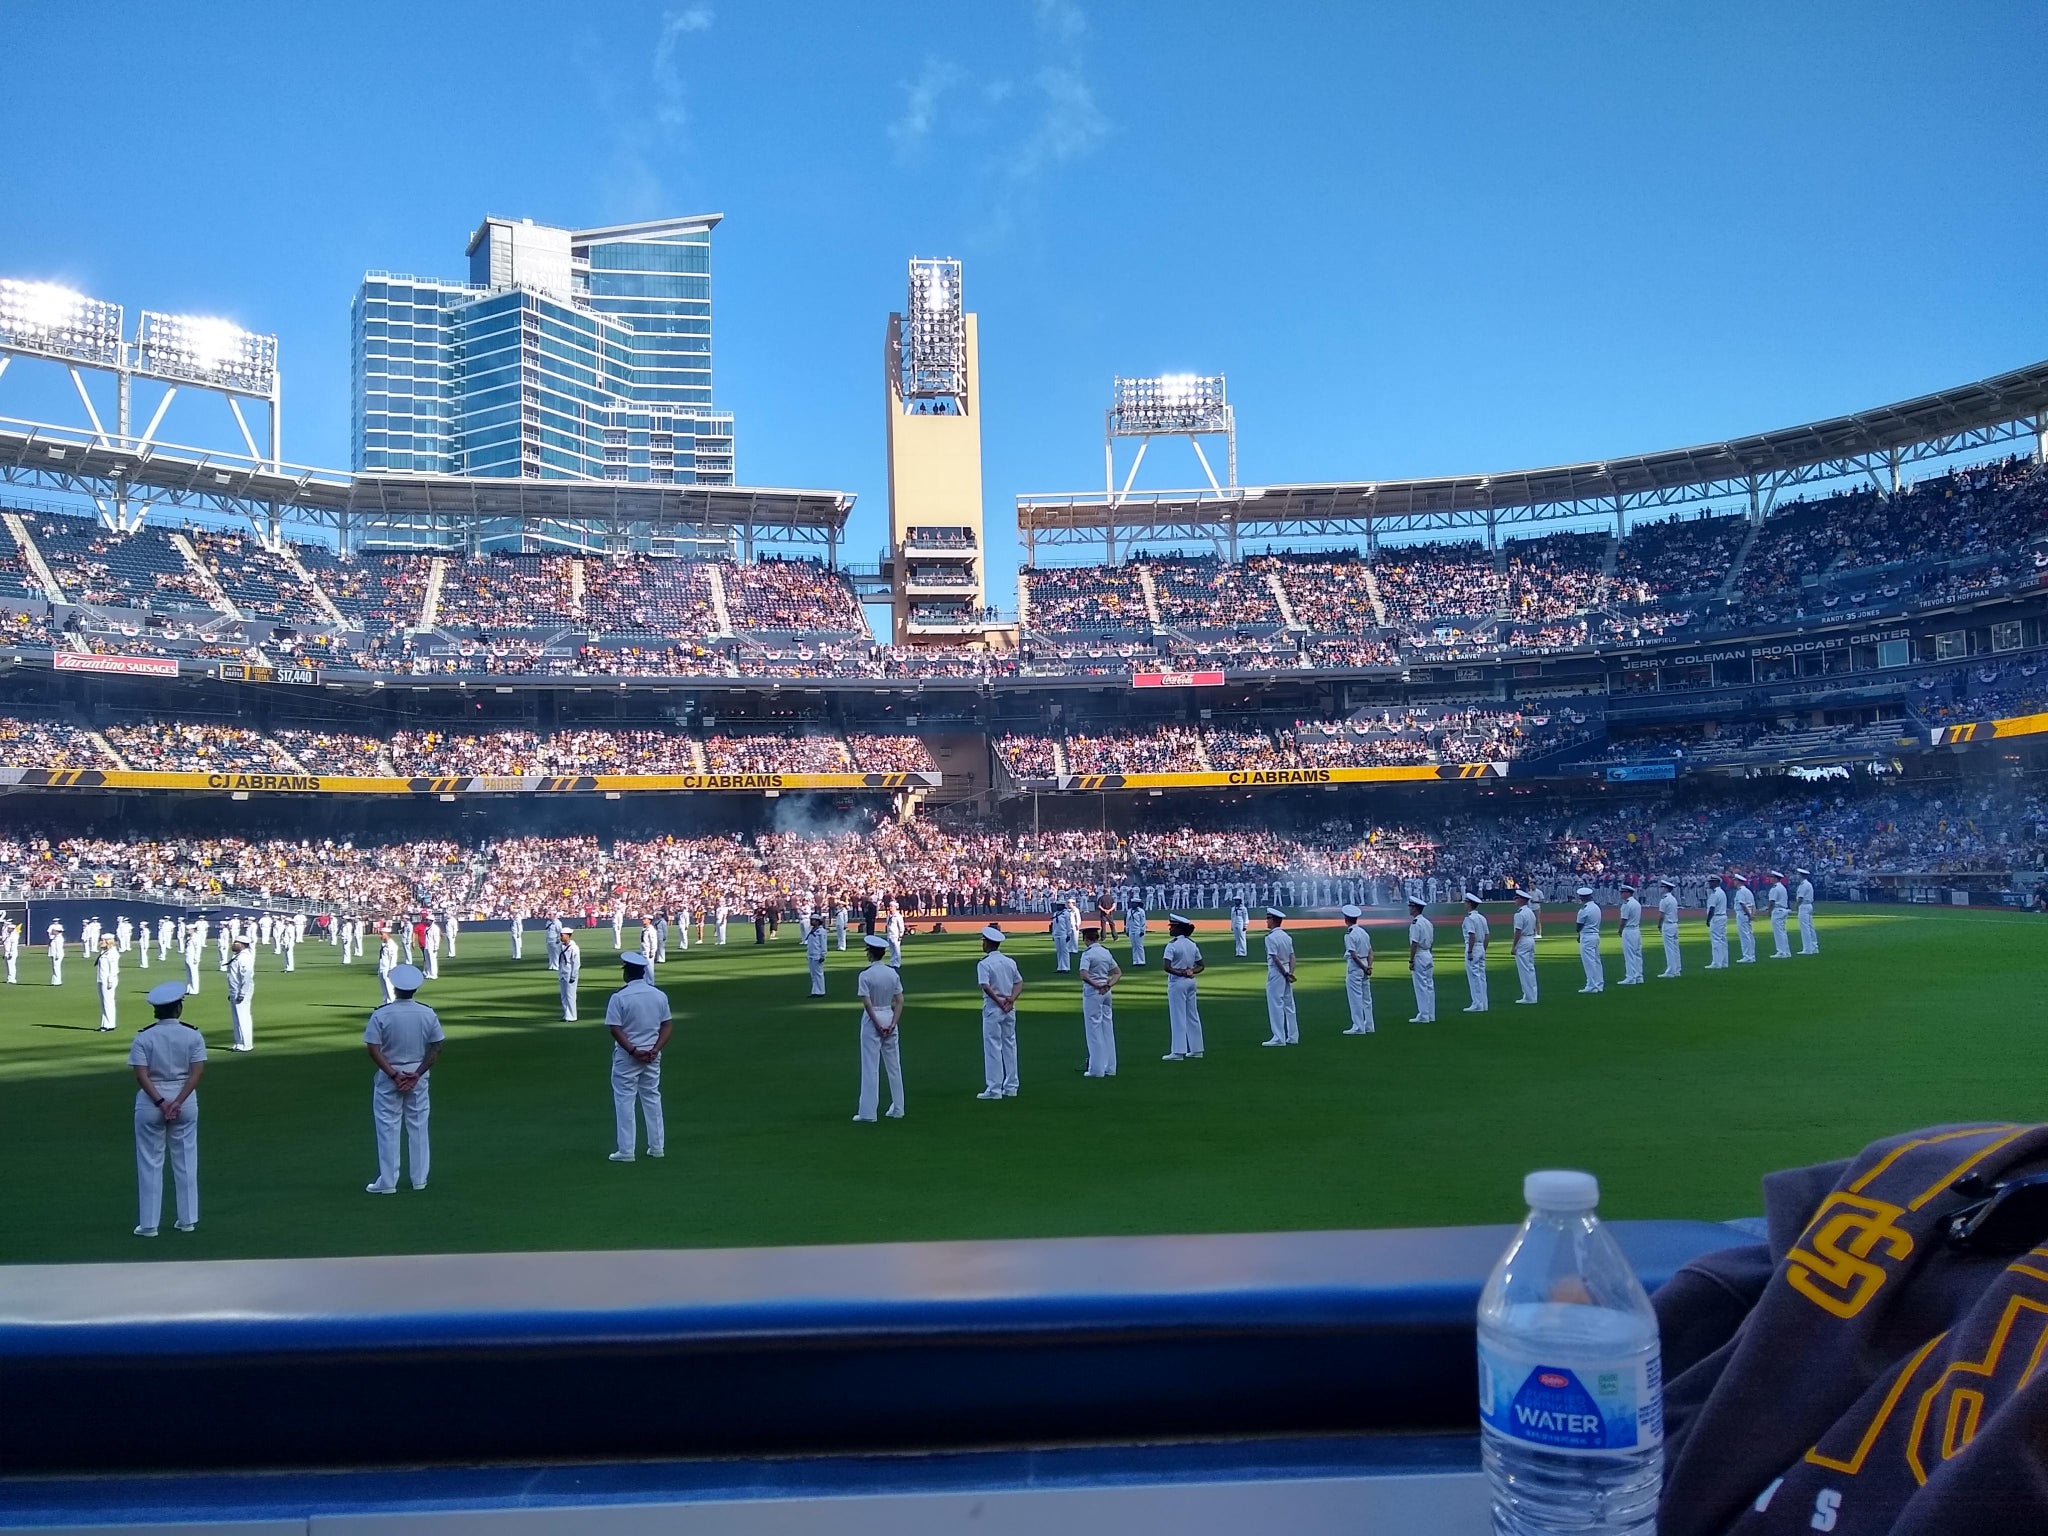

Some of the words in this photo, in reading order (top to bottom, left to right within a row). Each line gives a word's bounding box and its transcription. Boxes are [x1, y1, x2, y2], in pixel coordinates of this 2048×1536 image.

[1920, 598, 1944, 608] TREVOR
[1946, 595, 1955, 603] 51
[1957, 589, 1990, 601] HOFFMAN
[1821, 615, 1844, 624] RANDY
[1846, 612, 1856, 621] 35
[1857, 609, 1880, 619] JONES
[1646, 636, 1677, 645] WINFIELD
[1551, 646, 1574, 654] GWYNN
[1623, 658, 1668, 670] JERRY
[1674, 650, 1746, 665] COLEMAN
[1751, 638, 1844, 657] BROADCAST
[1850, 628, 1911, 645] CENTER
[57, 653, 125, 671] Tarantino
[127, 662, 177, 675] SAUSAGES
[1456, 653, 1481, 661] GARVEY
[277, 669, 312, 684] $17,440
[1408, 708, 1428, 717] RAK
[207, 773, 230, 789] CJ
[235, 774, 320, 790] ABRAMS
[683, 775, 701, 788] CJ
[707, 775, 783, 788] ABRAMS
[1228, 772, 1248, 784] CJ
[1252, 769, 1331, 784] ABRAMS
[1515, 1404, 1599, 1434] WATER
